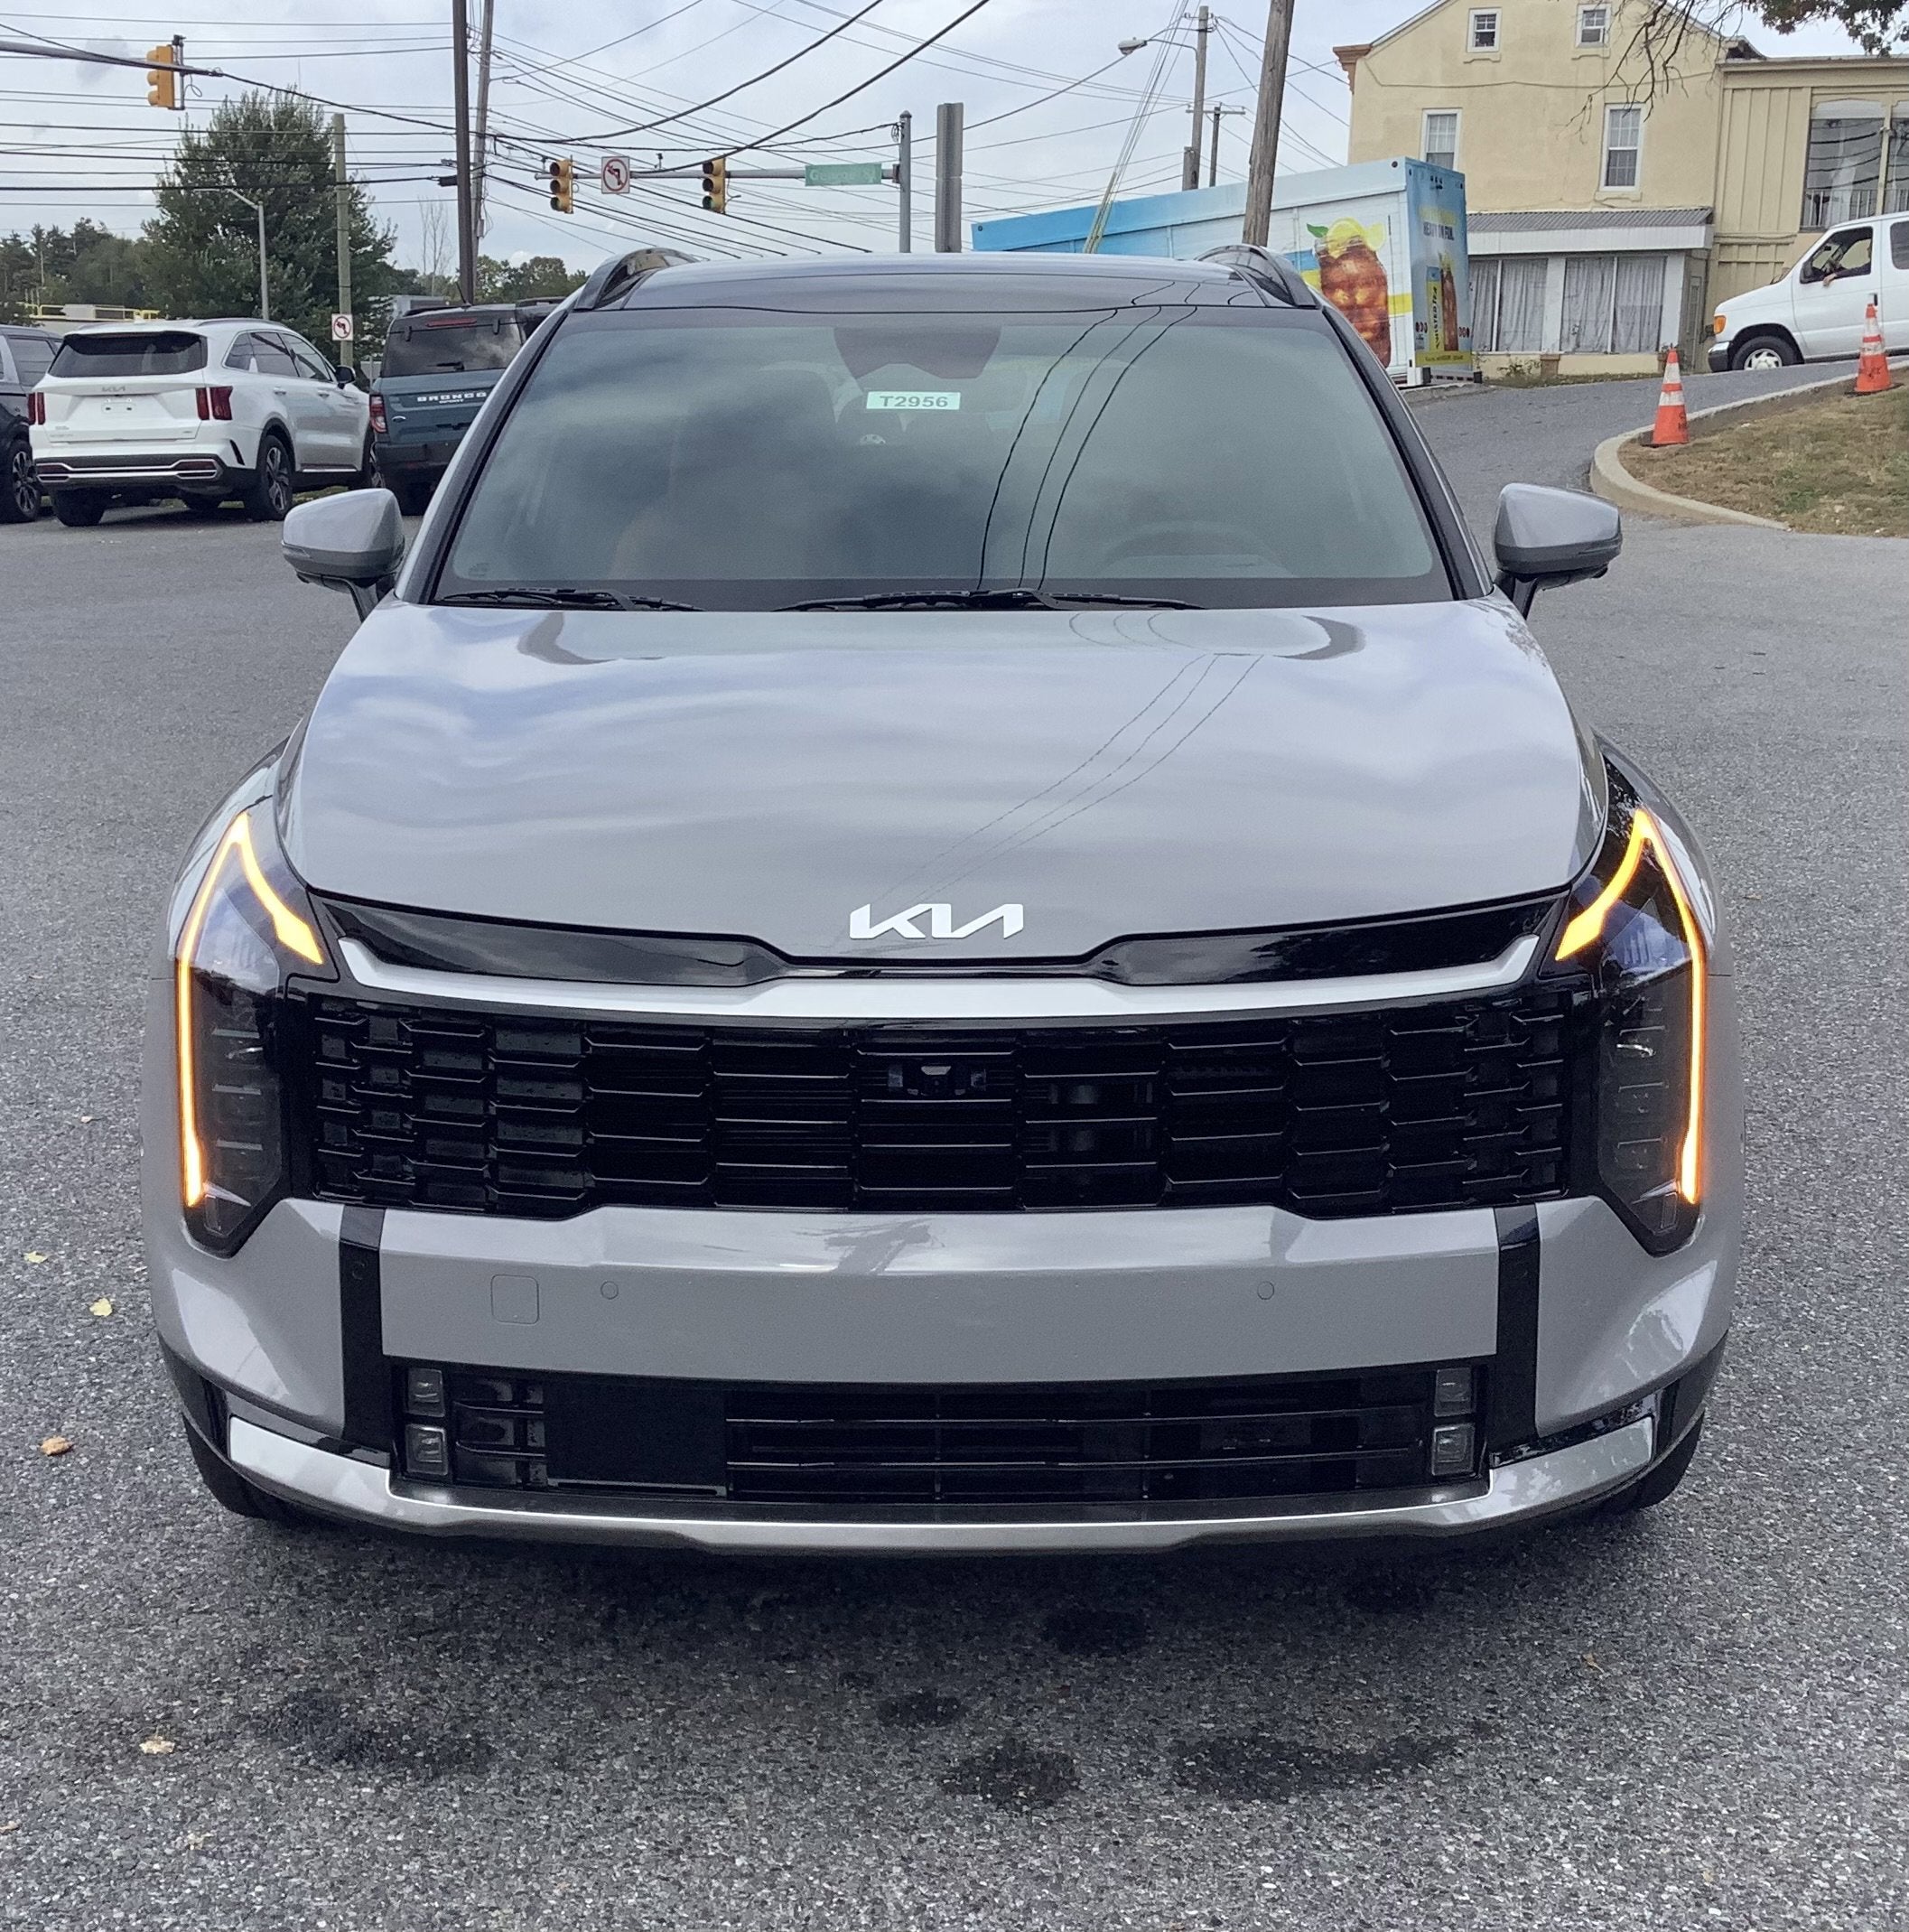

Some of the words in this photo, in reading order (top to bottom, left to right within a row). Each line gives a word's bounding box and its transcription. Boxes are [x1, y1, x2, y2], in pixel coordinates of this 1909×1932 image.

[416, 391, 487, 402] BRONCO
[880, 396, 949, 408] T2956
[850, 903, 1025, 939] KIA
